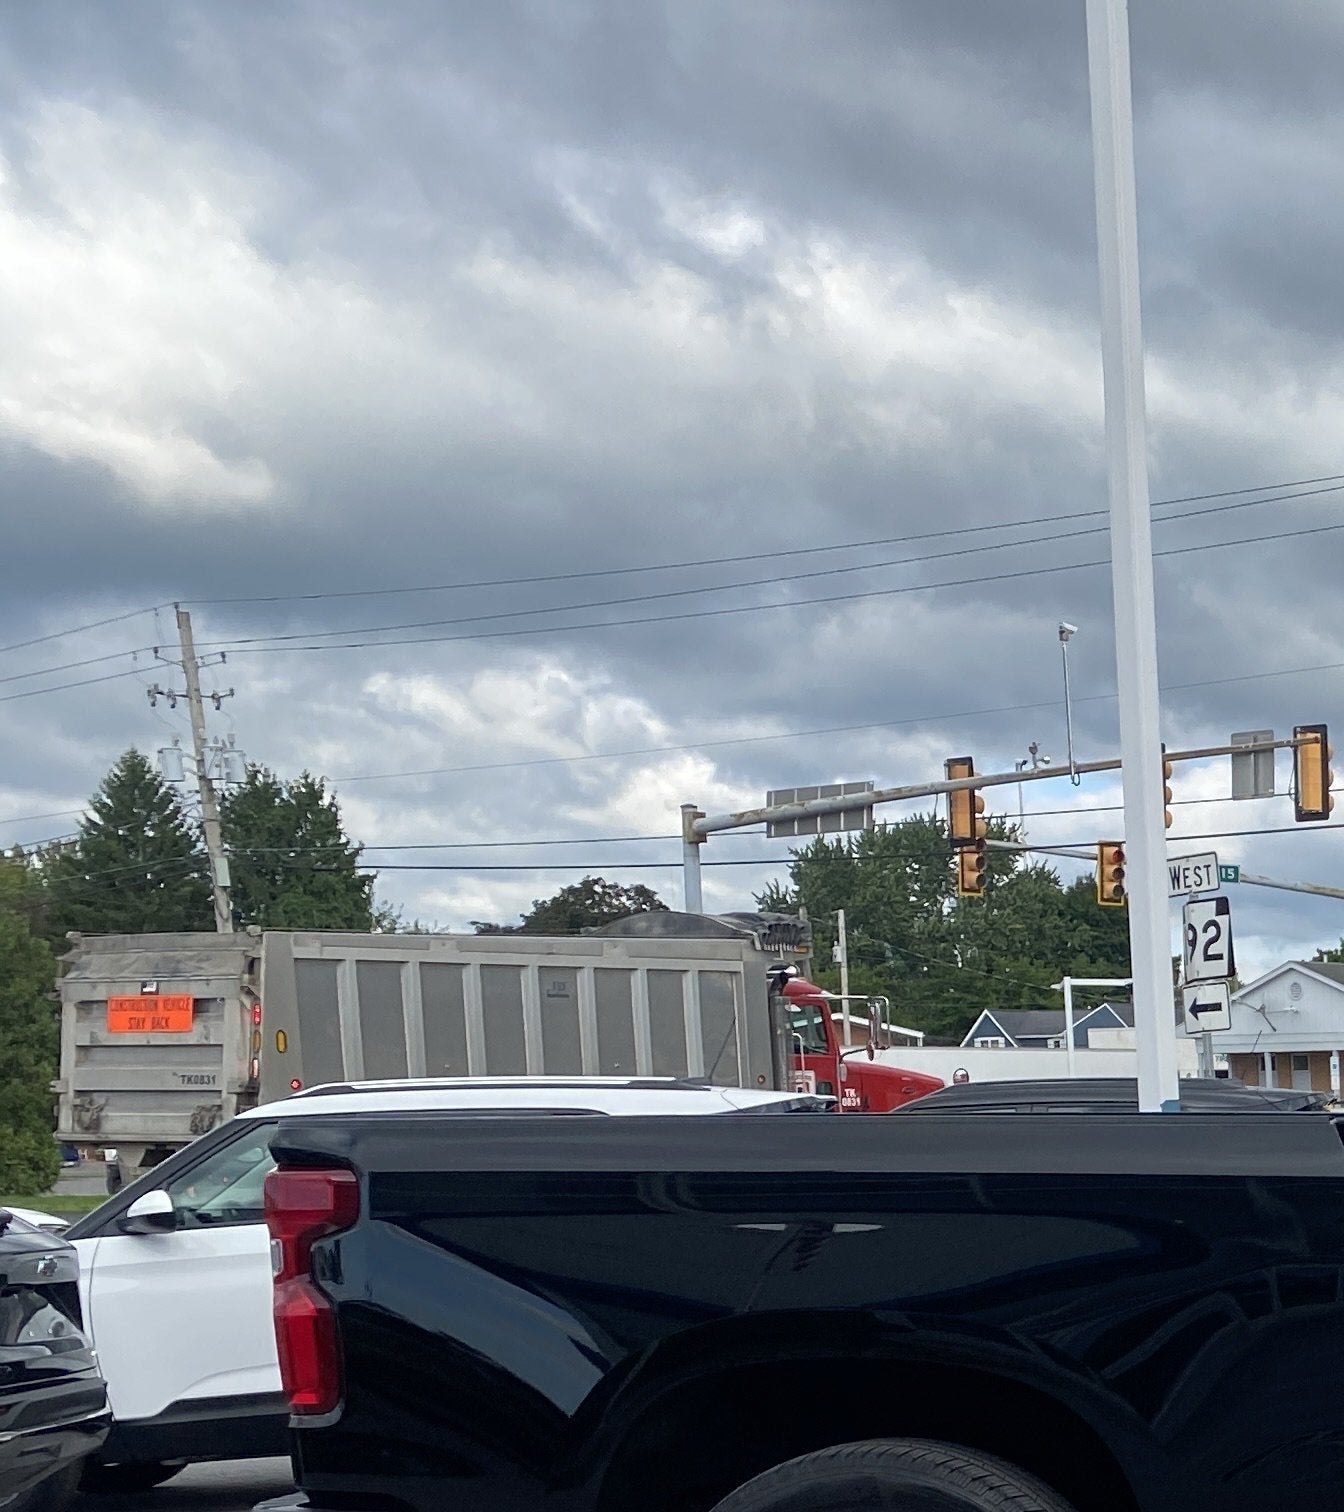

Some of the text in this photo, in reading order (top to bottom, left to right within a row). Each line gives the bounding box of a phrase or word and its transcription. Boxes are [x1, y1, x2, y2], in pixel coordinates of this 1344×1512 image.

[1168, 864, 1212, 890] WEST
[1221, 867, 1235, 880] 15
[1187, 919, 1224, 962] 92
[127, 1016, 170, 1029] STAY BACK
[844, 1088, 857, 1097] TK
